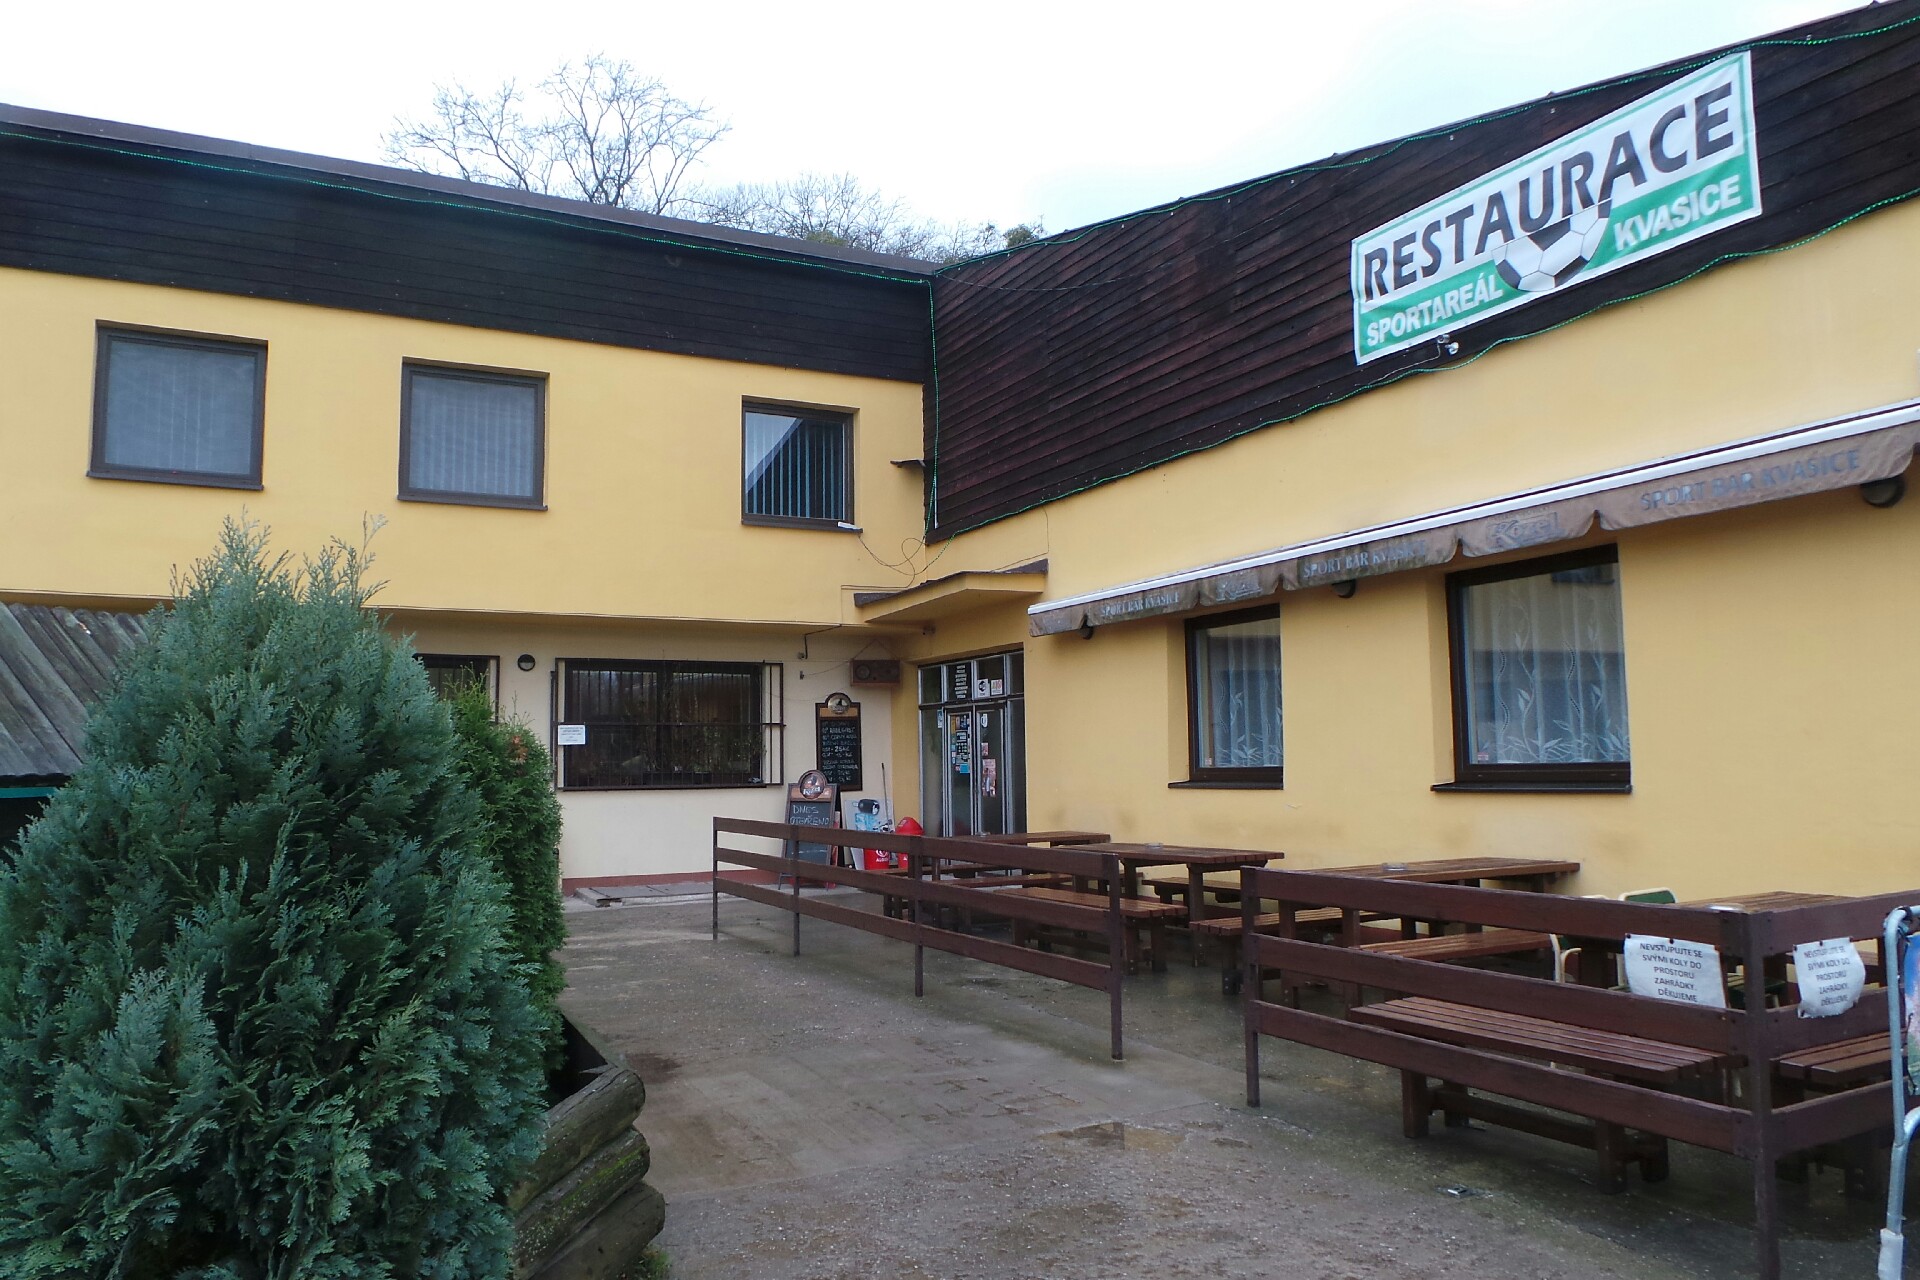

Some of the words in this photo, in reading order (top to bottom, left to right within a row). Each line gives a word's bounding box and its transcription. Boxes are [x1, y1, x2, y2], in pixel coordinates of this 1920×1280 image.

[1364, 82, 1734, 302] RESTAURACE
[1367, 272, 1503, 347] SPORTAREÁL
[1614, 175, 1741, 252] KVASICE
[1640, 481, 1705, 511] SPORT
[1713, 472, 1755, 496] BAR
[1760, 449, 1860, 486] KVASICE
[1303, 558, 1341, 578] SPORT
[1345, 551, 1369, 569] BAR
[1101, 601, 1126, 616] SPORT
[1128, 598, 1144, 612] BAR
[793, 804, 819, 814] DNES
[790, 814, 829, 826] OTEVŘENO
[1640, 943, 1692, 956] NEVSTUPUJTE
[1693, 950, 1703, 958] SE
[1642, 954, 1668, 964] SVÝMI
[1669, 957, 1688, 967] KOLY
[1690, 961, 1702, 970] DO
[1653, 966, 1695, 979] PROSTORU
[1658, 988, 1698, 1002] DĚKUJEME
